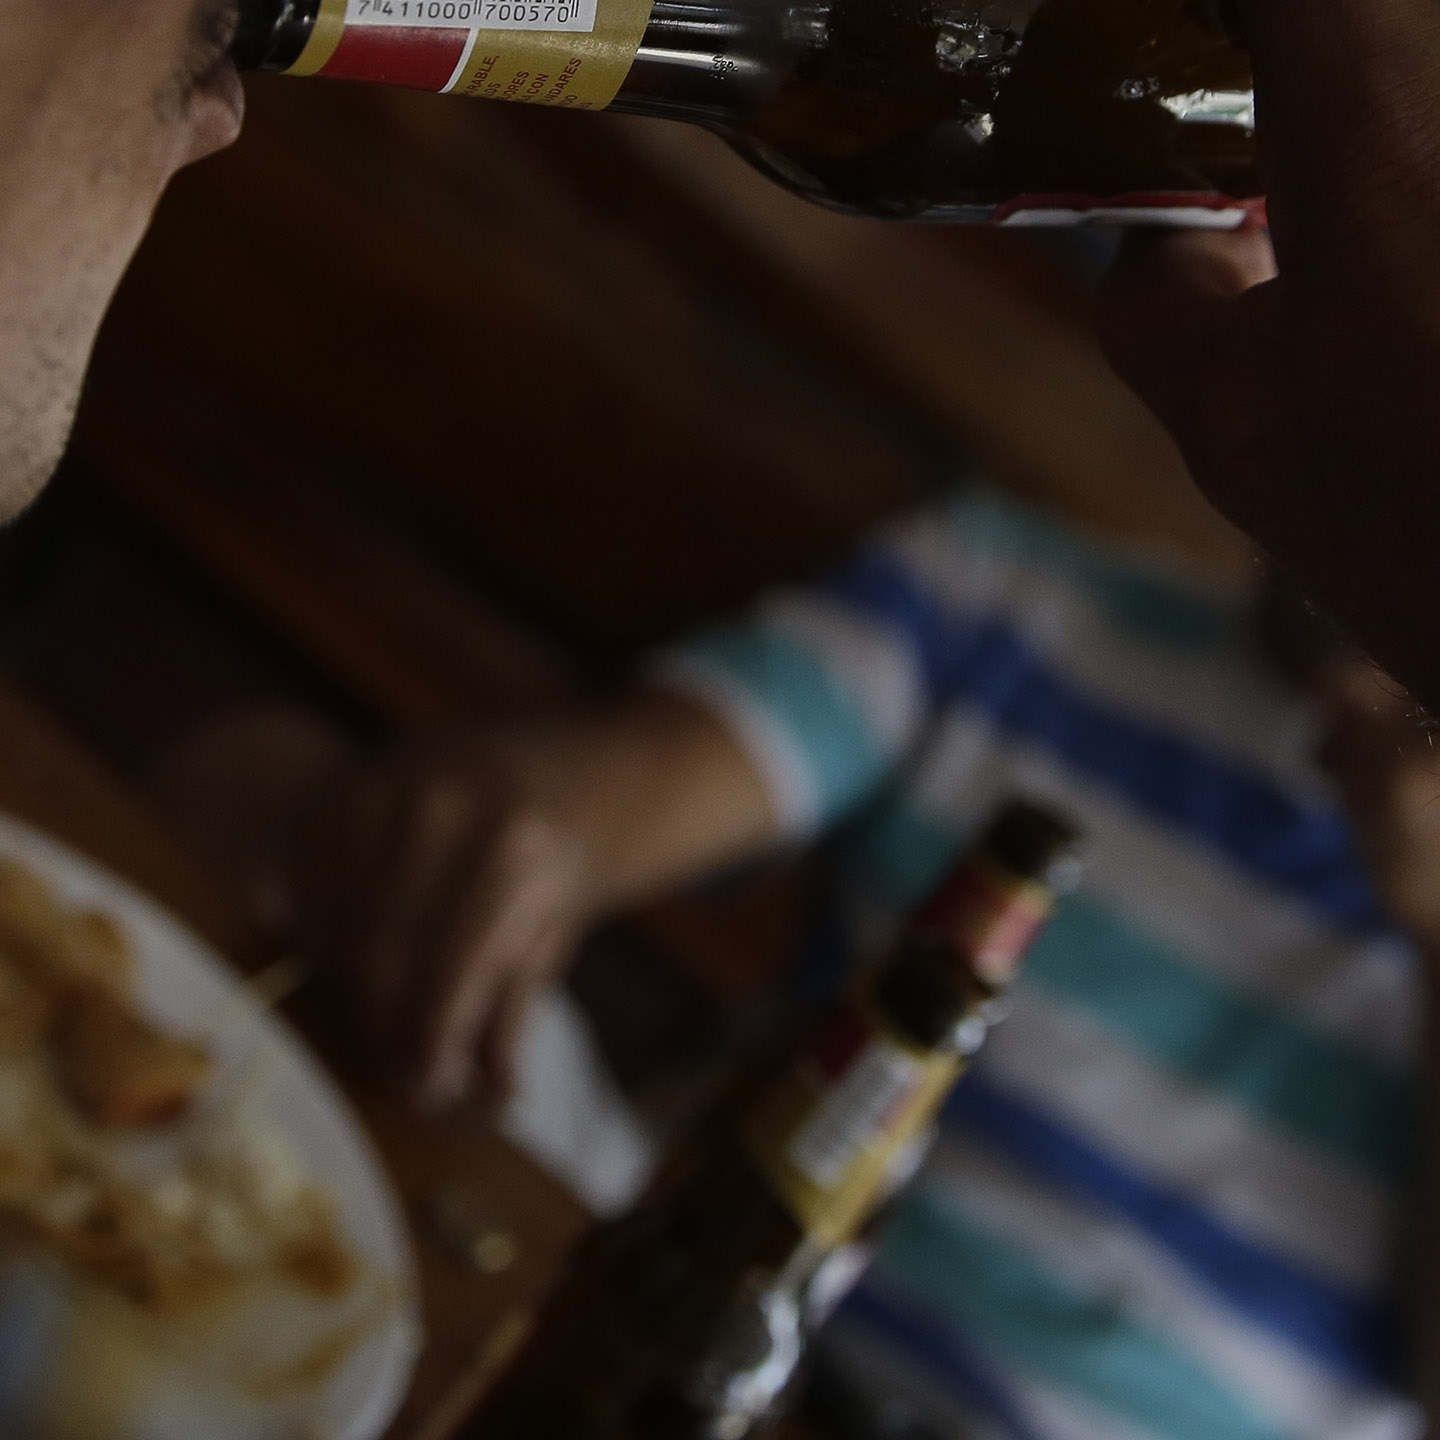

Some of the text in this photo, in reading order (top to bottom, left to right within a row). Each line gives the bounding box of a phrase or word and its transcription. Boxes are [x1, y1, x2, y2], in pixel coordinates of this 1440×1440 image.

[382, 1, 471, 20] 411000
[485, 3, 570, 23] 700570
[526, 72, 550, 95] CON
